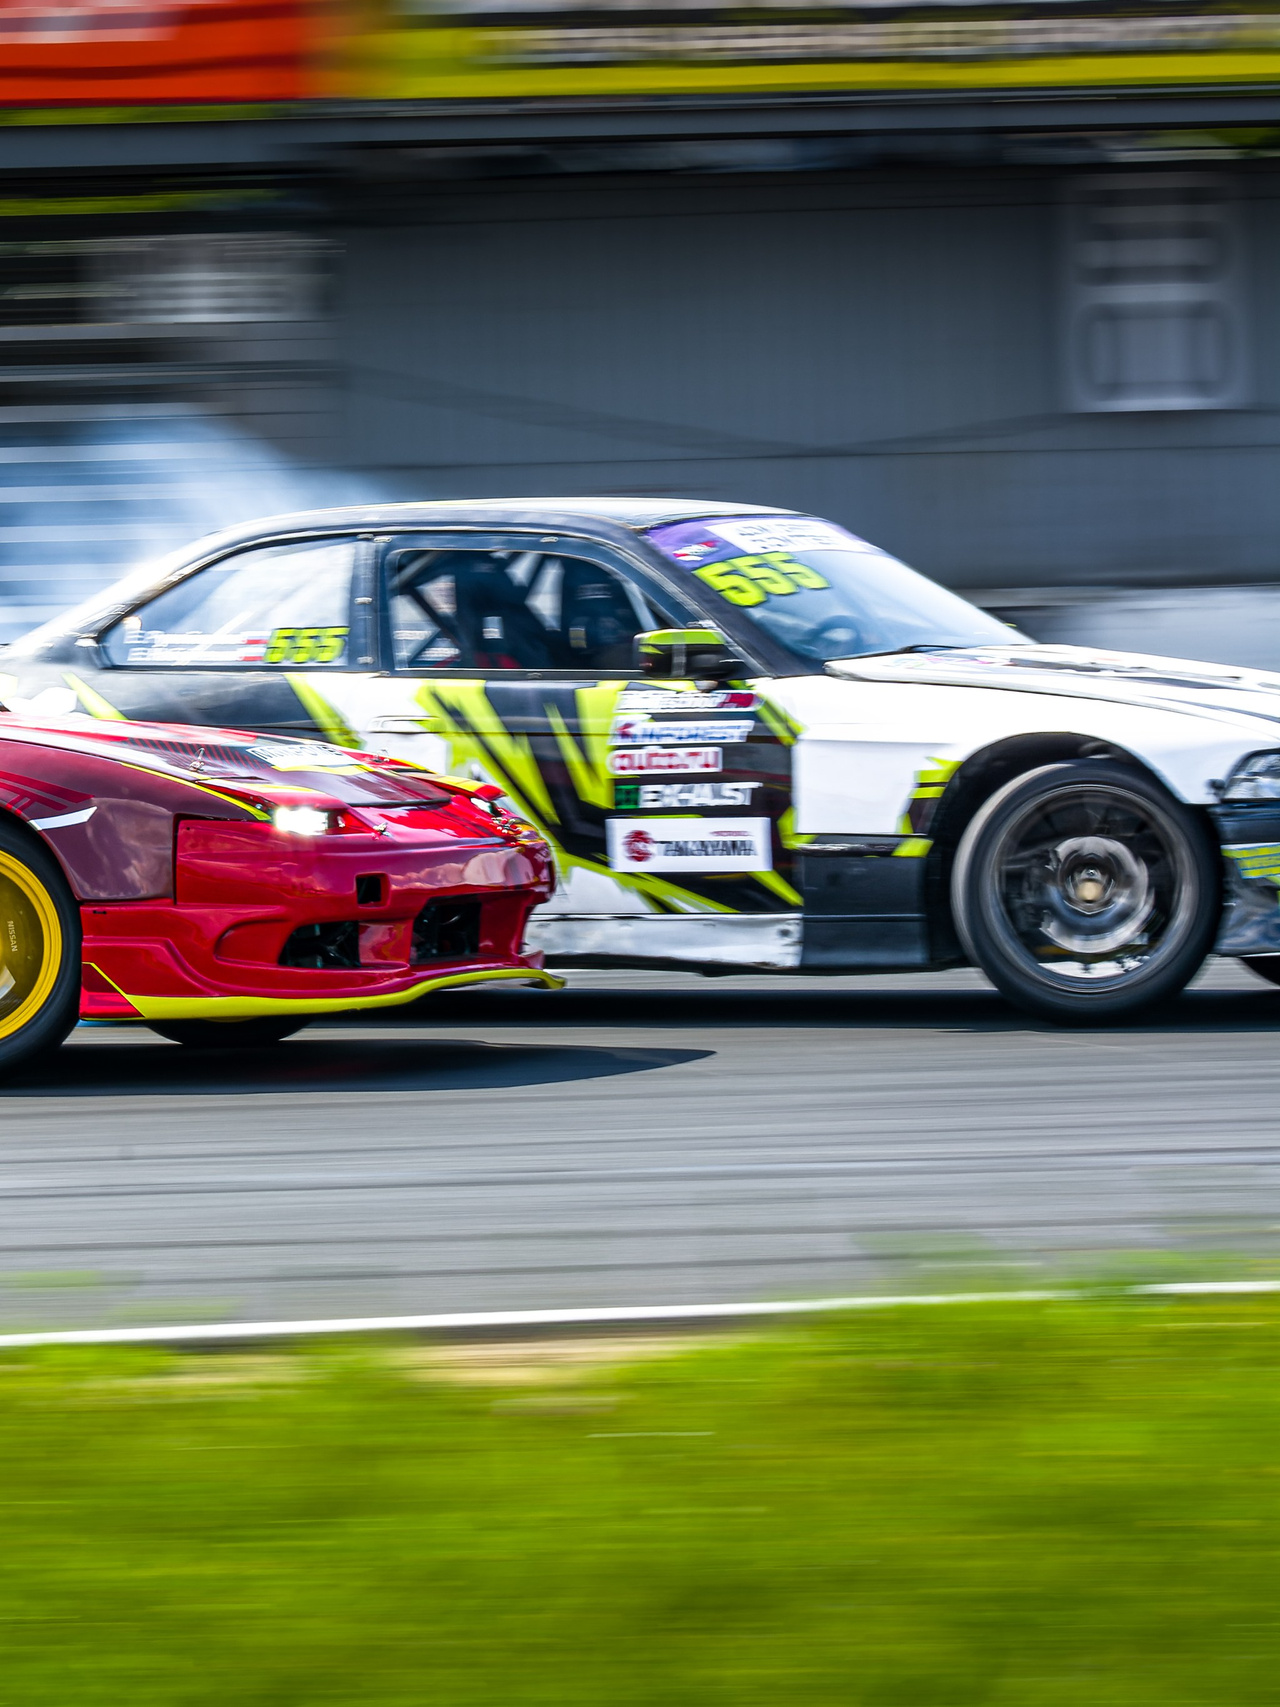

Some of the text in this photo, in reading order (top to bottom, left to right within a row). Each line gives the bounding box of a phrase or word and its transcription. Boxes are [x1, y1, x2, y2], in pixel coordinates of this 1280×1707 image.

[692, 551, 831, 606] 555
[264, 627, 350, 663] 555
[7, 920, 18, 952] NISSAN
